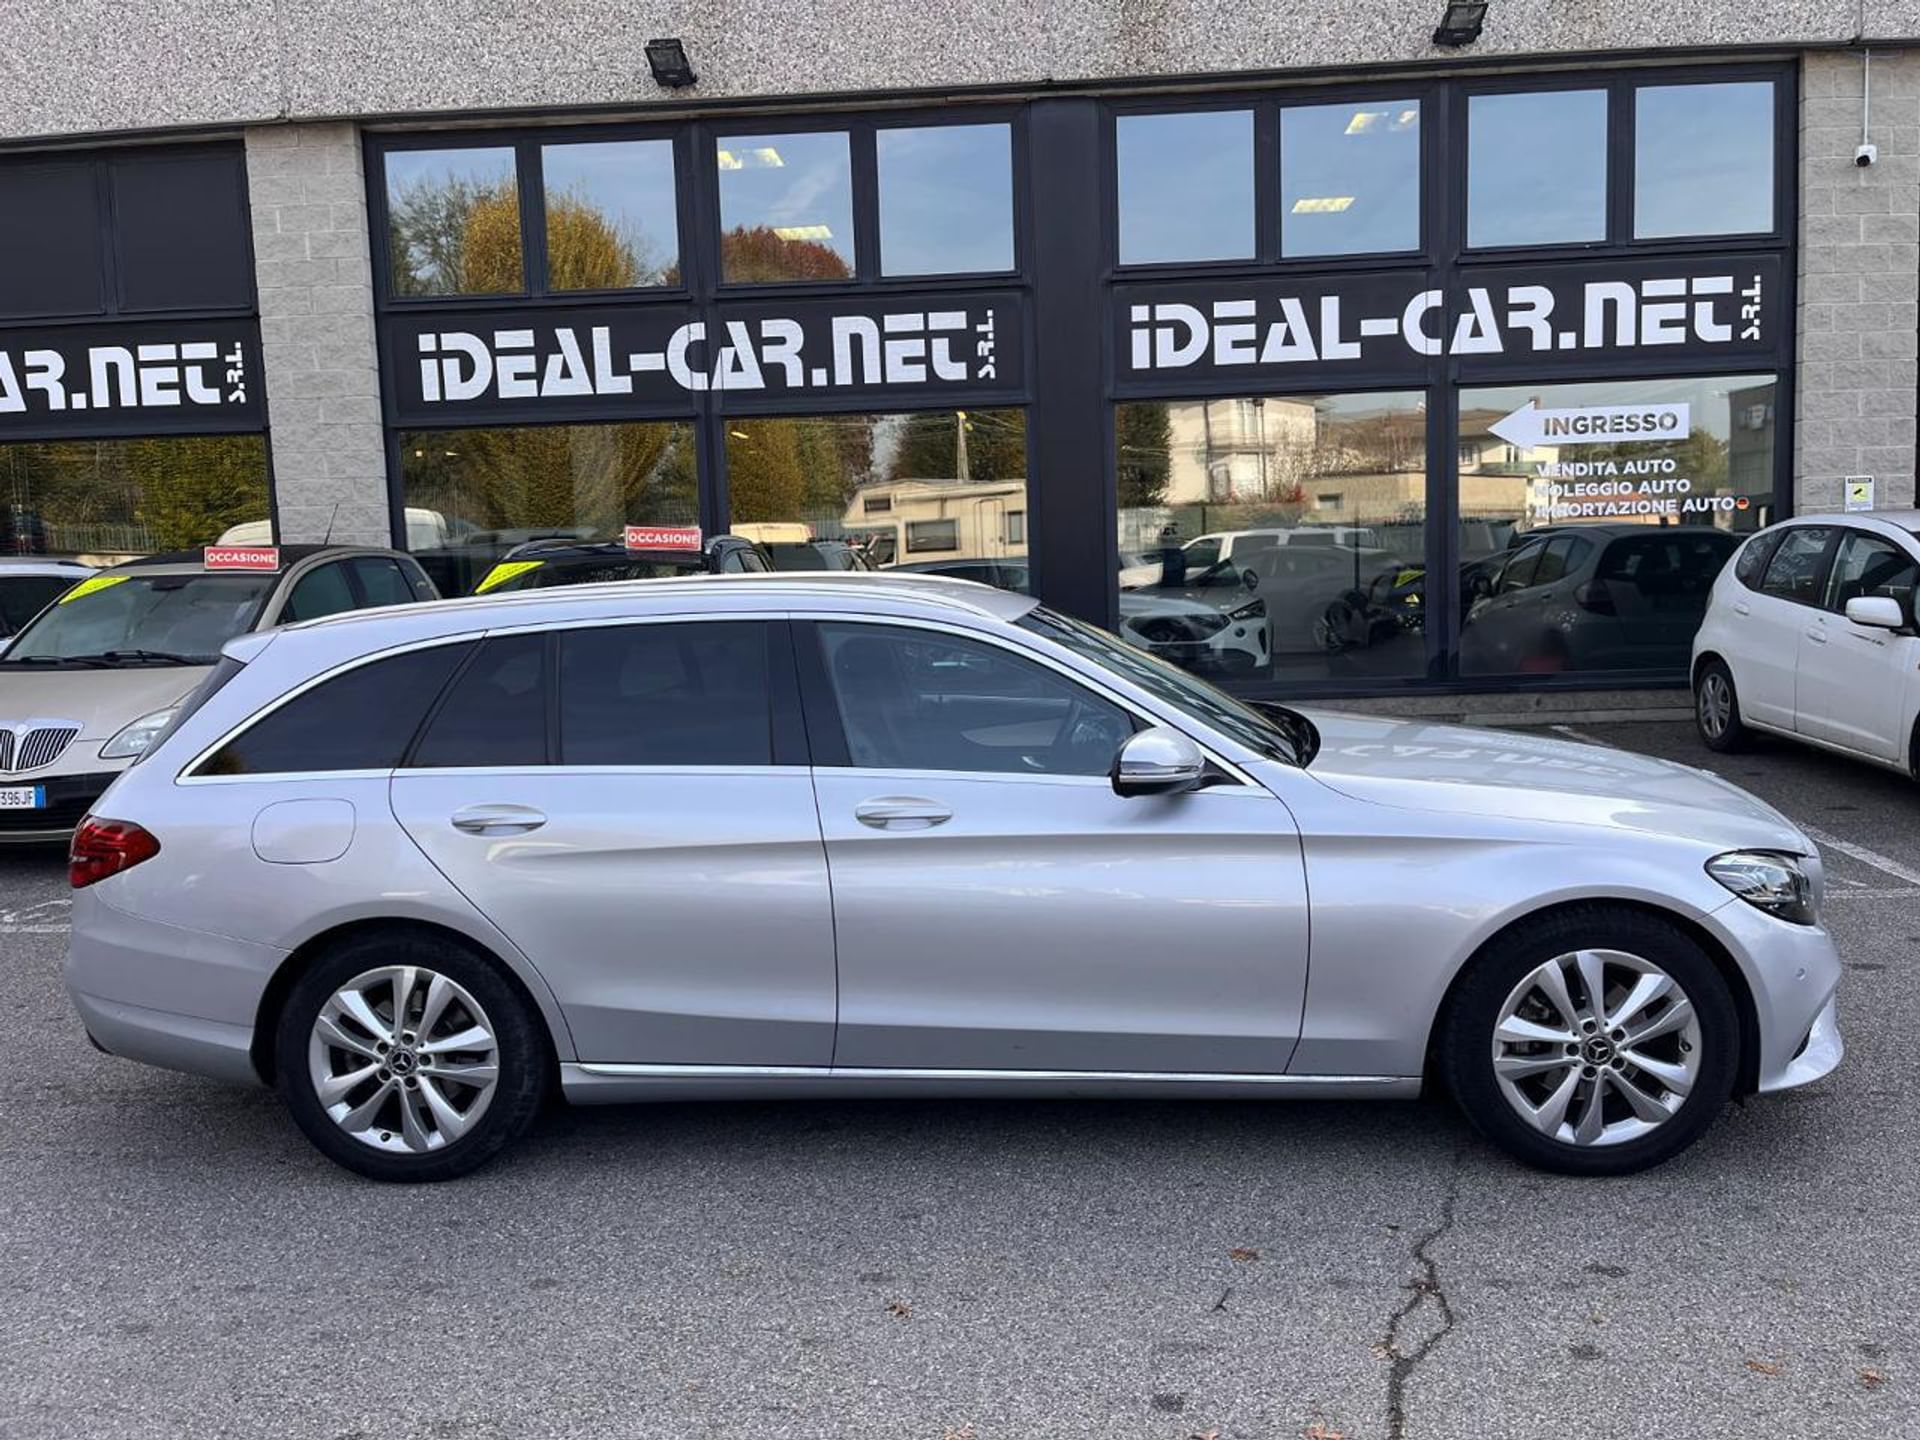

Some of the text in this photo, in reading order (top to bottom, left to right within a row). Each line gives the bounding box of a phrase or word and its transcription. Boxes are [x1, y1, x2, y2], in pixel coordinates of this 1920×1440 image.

[1131, 275, 1761, 369] IDEAL-CAR.NET S.R.L.
[418, 309, 996, 402] IDEAL-CAR.NET S.R.L.
[225, 342, 246, 404] S.R.L.
[1544, 412, 1678, 436] INGRESSO
[1536, 459, 1676, 478] VENDITA AUTO
[1638, 479, 1691, 494] AUTO
[1681, 496, 1736, 512] AUTO
[628, 527, 699, 545] OCCASIONE
[206, 551, 277, 564] OCCASIONE
